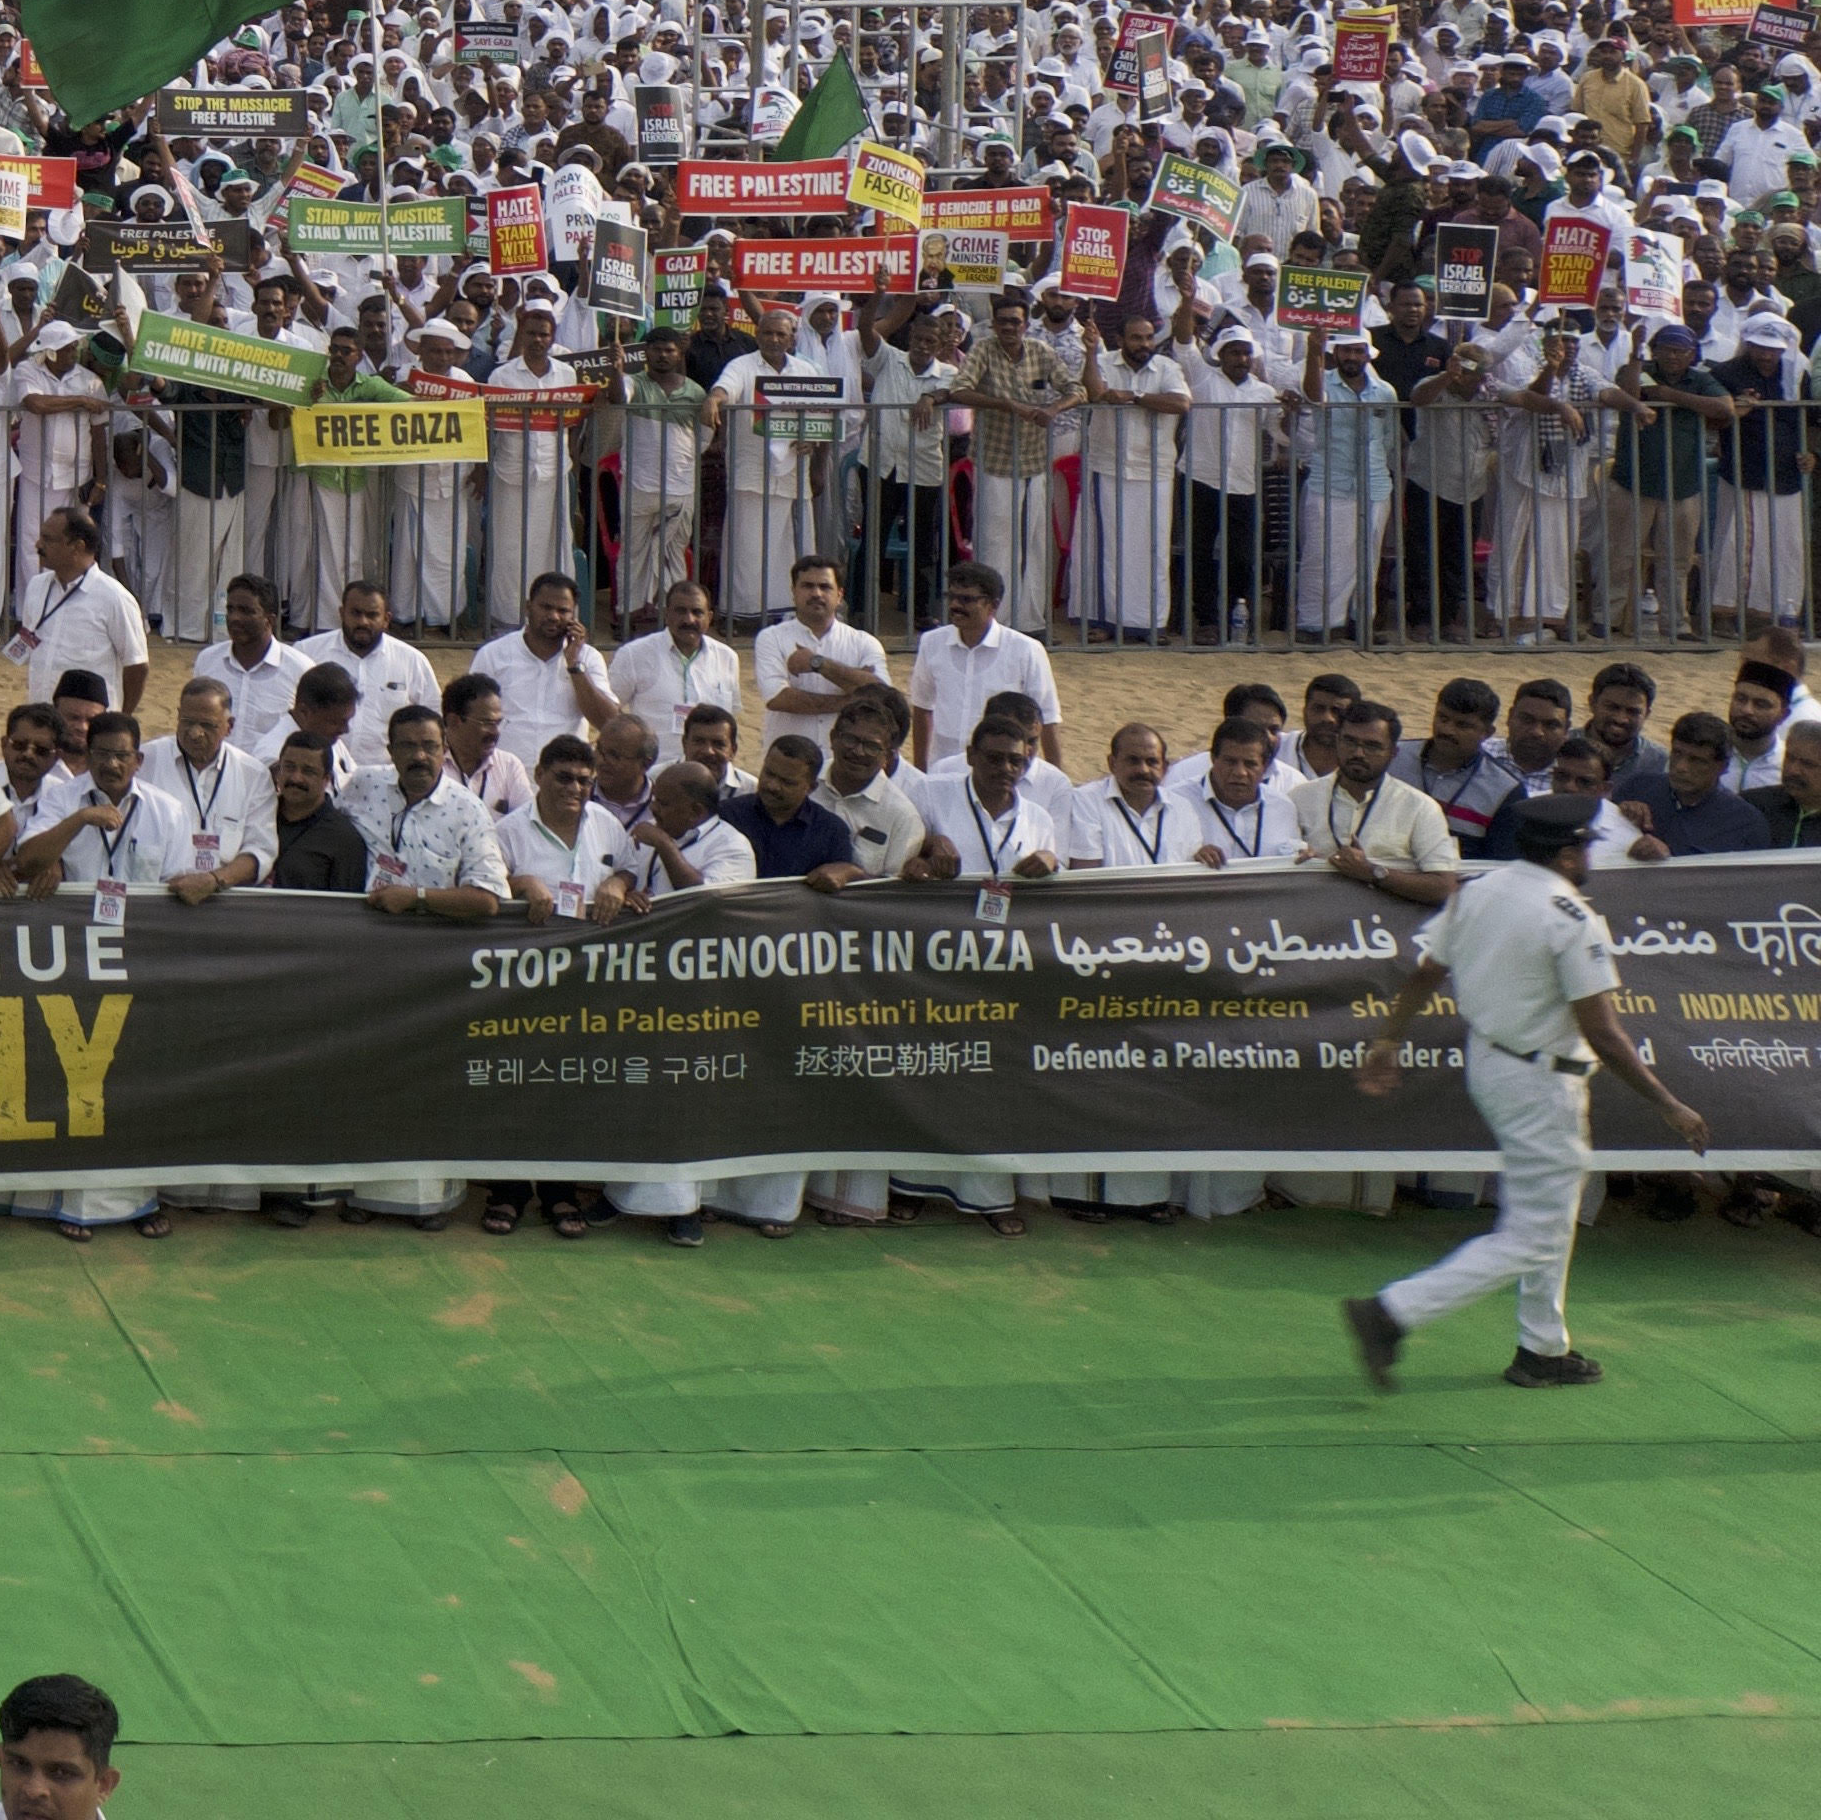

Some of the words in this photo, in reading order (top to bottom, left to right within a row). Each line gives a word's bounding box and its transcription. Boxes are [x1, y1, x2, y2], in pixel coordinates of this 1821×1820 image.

[174, 96, 203, 110] STOP
[207, 97, 226, 110] THE
[229, 98, 292, 112] MASSACRE
[191, 112, 216, 125] FREE
[220, 112, 275, 126] PALESTINE
[689, 174, 735, 197] FREE
[741, 172, 844, 197] PALESTINE
[864, 174, 919, 205] FASCISM
[1171, 161, 1195, 179] FREE
[1197, 170, 1238, 199] PALESTINE
[497, 197, 533, 218] HATE
[297, 223, 342, 242] STAND
[345, 224, 379, 240] WITH
[496, 225, 536, 243] STAND
[1077, 227, 1110, 242] STOP
[1556, 227, 1599, 249] HATE
[501, 240, 535, 256] WITH
[952, 238, 999, 252] CRIME
[1071, 242, 1115, 259] ISRAEL
[601, 258, 636, 277] ISRAEL
[666, 256, 697, 271] GAZA
[951, 252, 998, 264] MINISTER
[1549, 255, 1594, 269] STAND
[666, 272, 695, 288] WILL
[1443, 264, 1484, 280] ISRAEL
[1551, 270, 1586, 285] WITH
[596, 272, 641, 294] TERRORISM
[662, 289, 698, 307] NEVER
[673, 308, 692, 324] DIE
[170, 326, 207, 350] HATE
[210, 336, 290, 369] TERRORISM
[145, 342, 189, 366] STAND
[194, 352, 229, 375] WITH
[233, 361, 307, 392] PALESTINE
[414, 380, 446, 397] STOP
[315, 414, 379, 447] FREE
[392, 412, 462, 445] GAZA
[1051, 922, 1210, 979] وشعبها
[1227, 915, 1397, 976] فلسطين
[470, 947, 571, 988] STOP
[582, 941, 657, 982] THE
[668, 931, 861, 981] GENOCIDE
[872, 931, 914, 972] IN
[926, 930, 1034, 972] GAZA
[801, 1000, 916, 1027] Filistin'i
[926, 998, 1019, 1023] kurtar
[1060, 995, 1200, 1019] Palästina
[1210, 999, 1308, 1018] retten
[1679, 994, 1790, 1020] INDIANS
[468, 1014, 571, 1037] sauver
[580, 1007, 606, 1033] la
[618, 1006, 760, 1032] Palestine
[795, 1041, 993, 1077] 拯救巴勒斯坦
[1034, 1041, 1146, 1071] Defiende
[1153, 1048, 1167, 1068] a
[1175, 1041, 1300, 1069] Palestina
[466, 1057, 651, 1085] 팔레스타인을
[662, 1053, 747, 1084] 구하다
